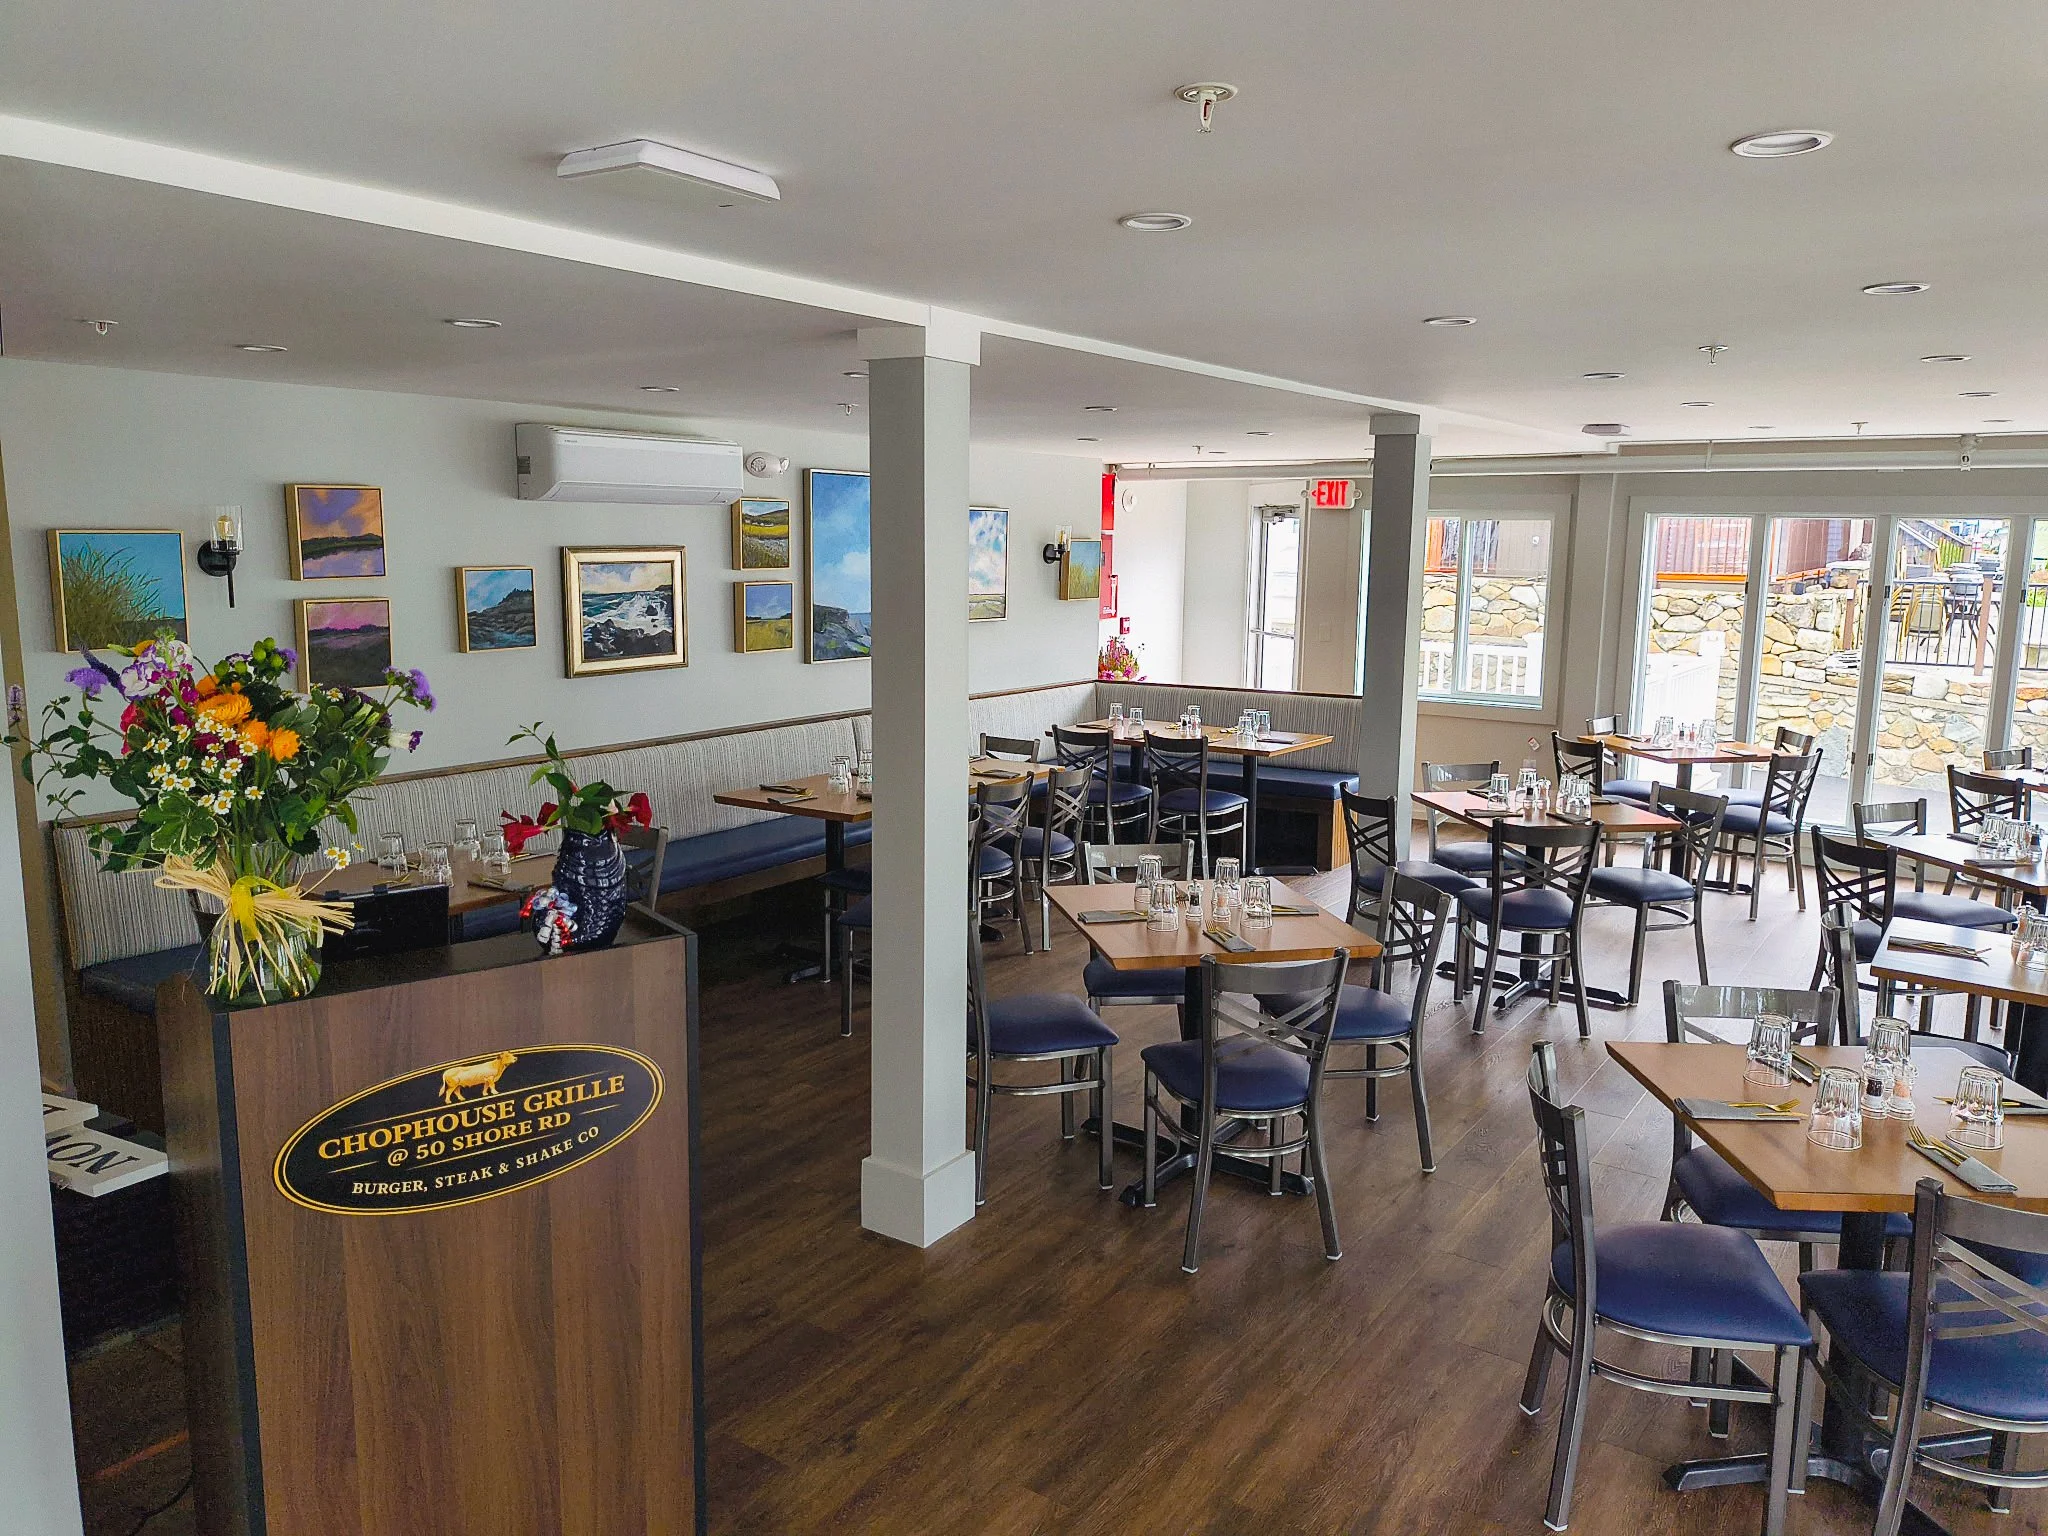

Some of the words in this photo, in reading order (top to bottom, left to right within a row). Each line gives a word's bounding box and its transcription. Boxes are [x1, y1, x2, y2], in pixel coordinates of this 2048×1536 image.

[1316, 481, 1349, 506] EXIT
[318, 1100, 517, 1159] CHOPHOUSE
[523, 1074, 625, 1113] GRILLE
[387, 1148, 409, 1167] @
[416, 1141, 446, 1160] 50
[452, 1119, 533, 1151] SHORE
[538, 1112, 571, 1131] RD
[351, 1180, 429, 1195] BURGER,
[434, 1167, 493, 1188] STEAK
[498, 1162, 510, 1175] &
[515, 1138, 574, 1169] SHAKE
[577, 1126, 600, 1144] CO
